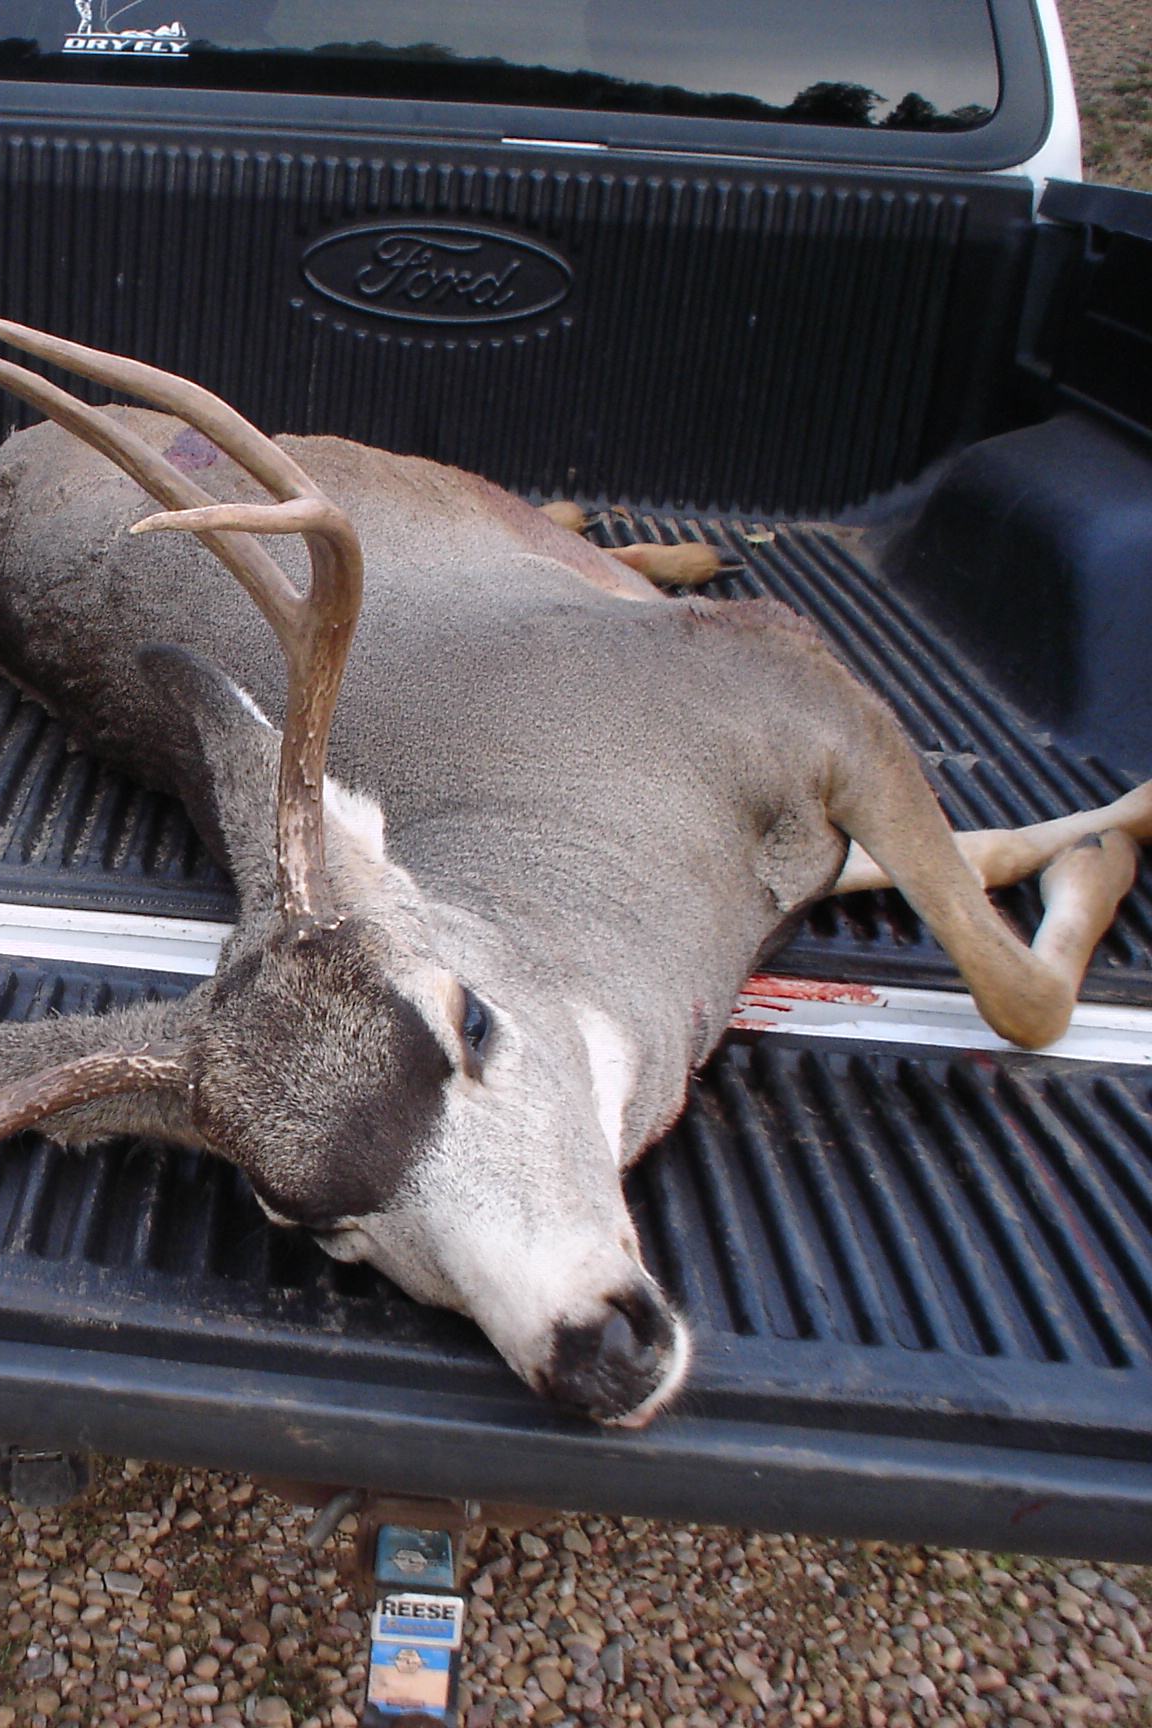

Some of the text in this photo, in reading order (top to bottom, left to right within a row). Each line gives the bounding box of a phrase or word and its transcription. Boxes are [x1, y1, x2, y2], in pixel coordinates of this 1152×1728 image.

[63, 38, 189, 53] DRY FLY
[354, 233, 521, 307] Ford
[380, 1600, 456, 1621] REESE
